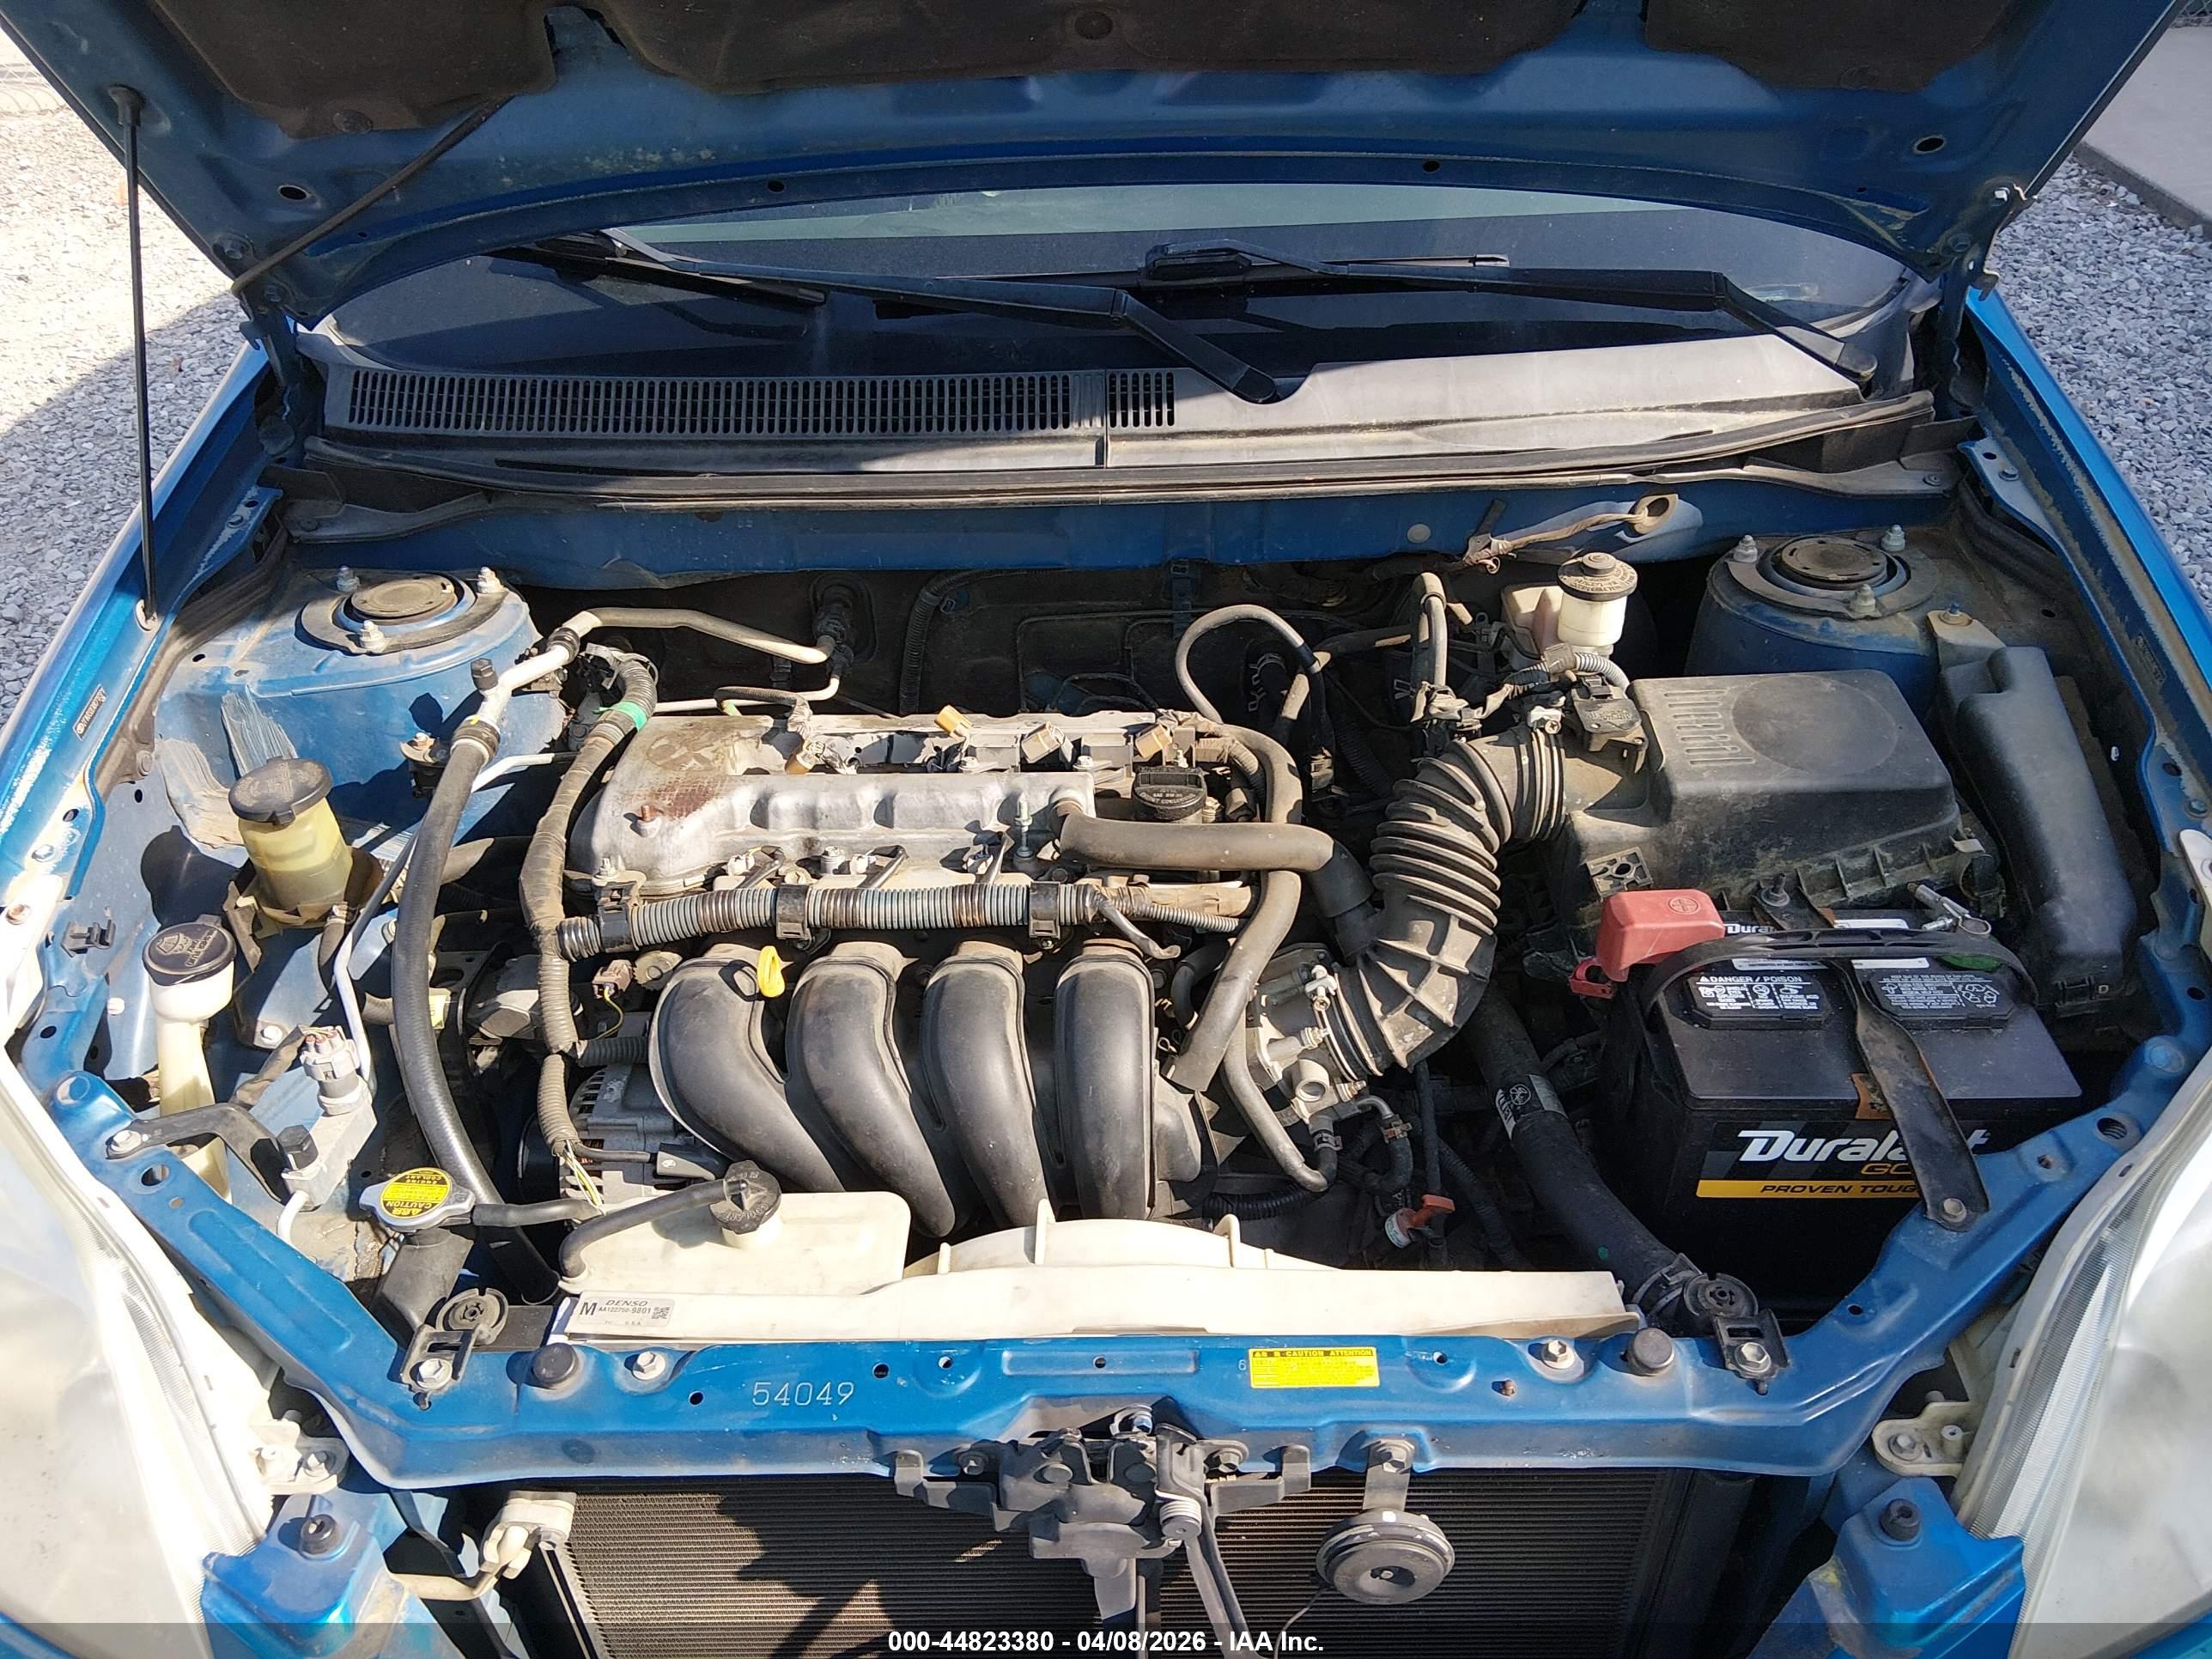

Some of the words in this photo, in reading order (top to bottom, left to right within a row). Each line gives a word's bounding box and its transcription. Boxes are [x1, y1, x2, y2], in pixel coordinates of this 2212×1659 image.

[1723, 923, 1774, 934] Dura
[1737, 1129, 1991, 1162] Duralt
[1759, 1185, 1853, 1194] PROVEN
[1857, 1184, 1918, 1194] TOUG
[579, 1302, 599, 1316] M
[752, 1381, 855, 1407] 54049
